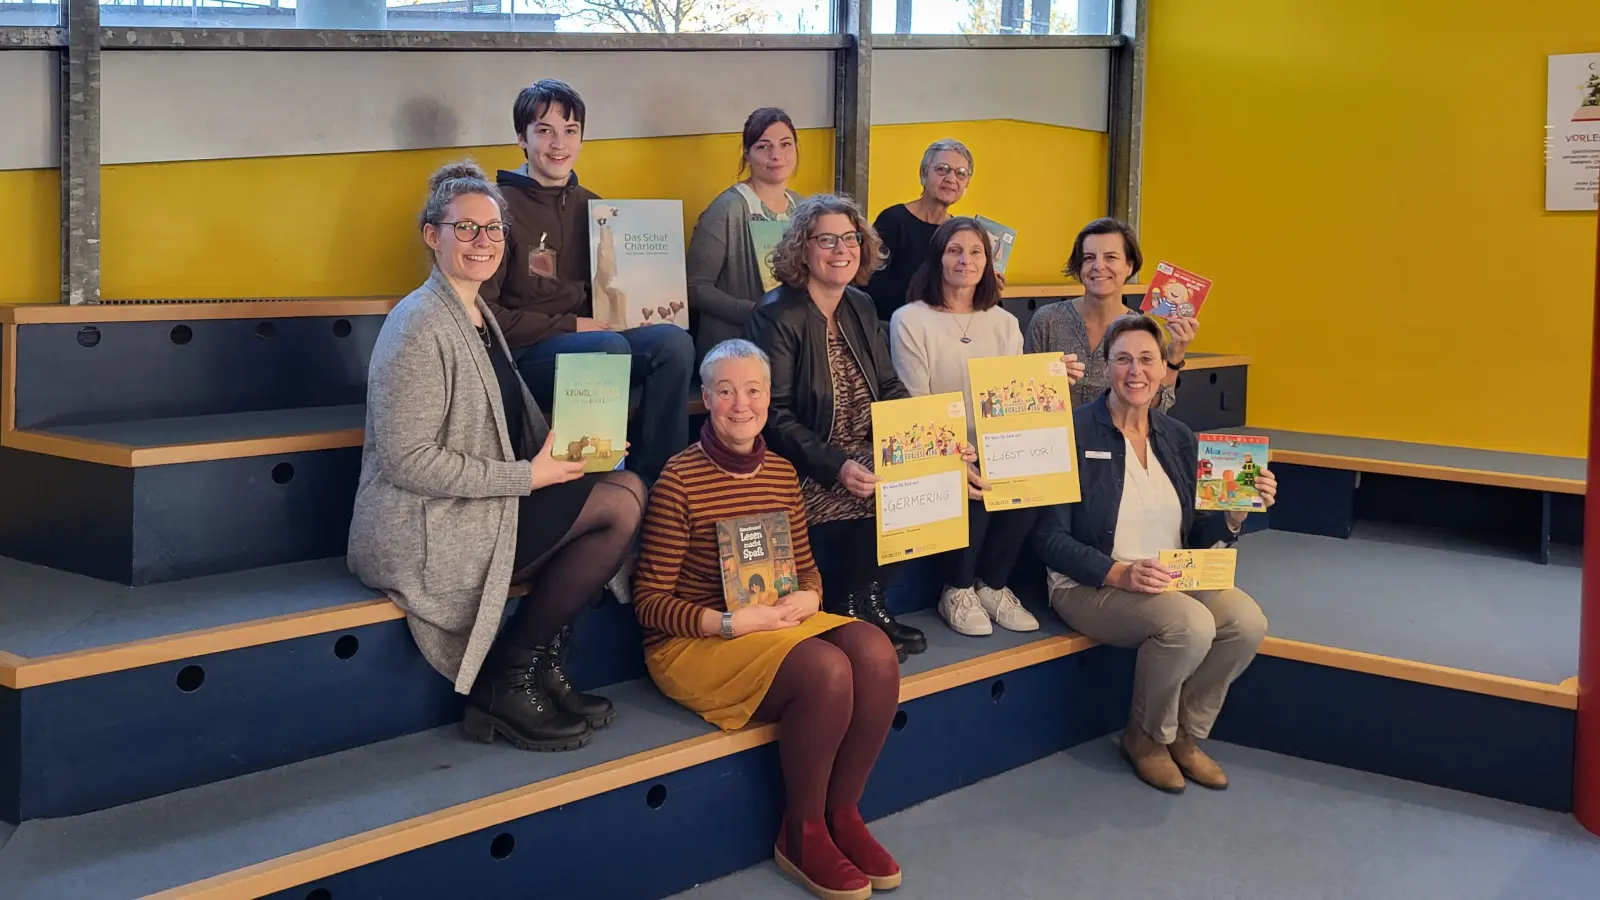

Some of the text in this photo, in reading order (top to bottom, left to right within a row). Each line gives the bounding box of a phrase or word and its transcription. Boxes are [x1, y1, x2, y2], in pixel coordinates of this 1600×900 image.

[624, 233, 667, 241] Das Schaf
[624, 242, 669, 251] Charlotte
[992, 449, 1025, 461] LIEST
[887, 490, 950, 512] GERMERING
[740, 532, 763, 542] Lesen
[743, 540, 762, 548] macht
[743, 546, 765, 561] Spaß
